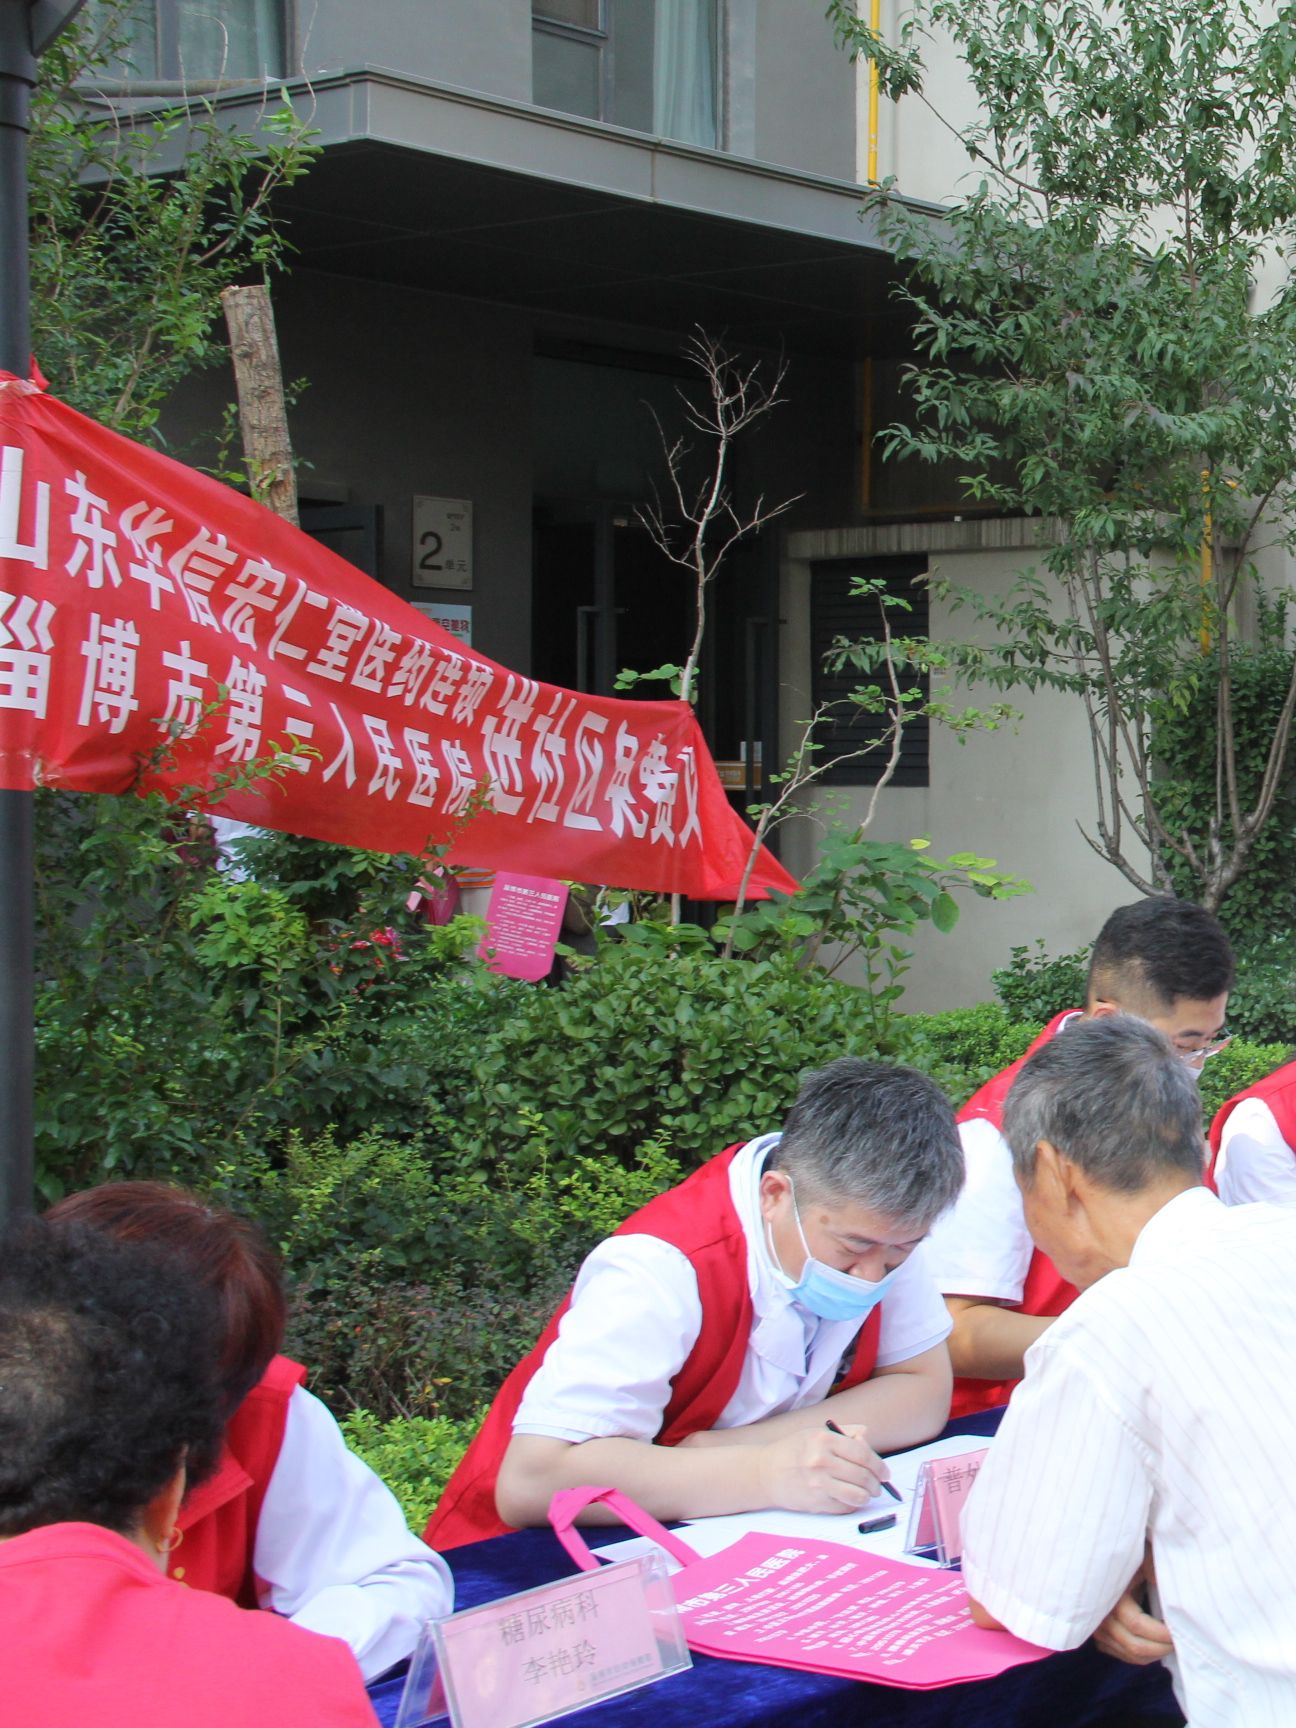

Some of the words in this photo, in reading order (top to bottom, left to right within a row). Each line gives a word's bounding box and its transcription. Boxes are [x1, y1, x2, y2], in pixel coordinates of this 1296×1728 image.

[499, 1589, 599, 1646] 糖尿病科
[522, 1639, 597, 1685] 李艳玲
